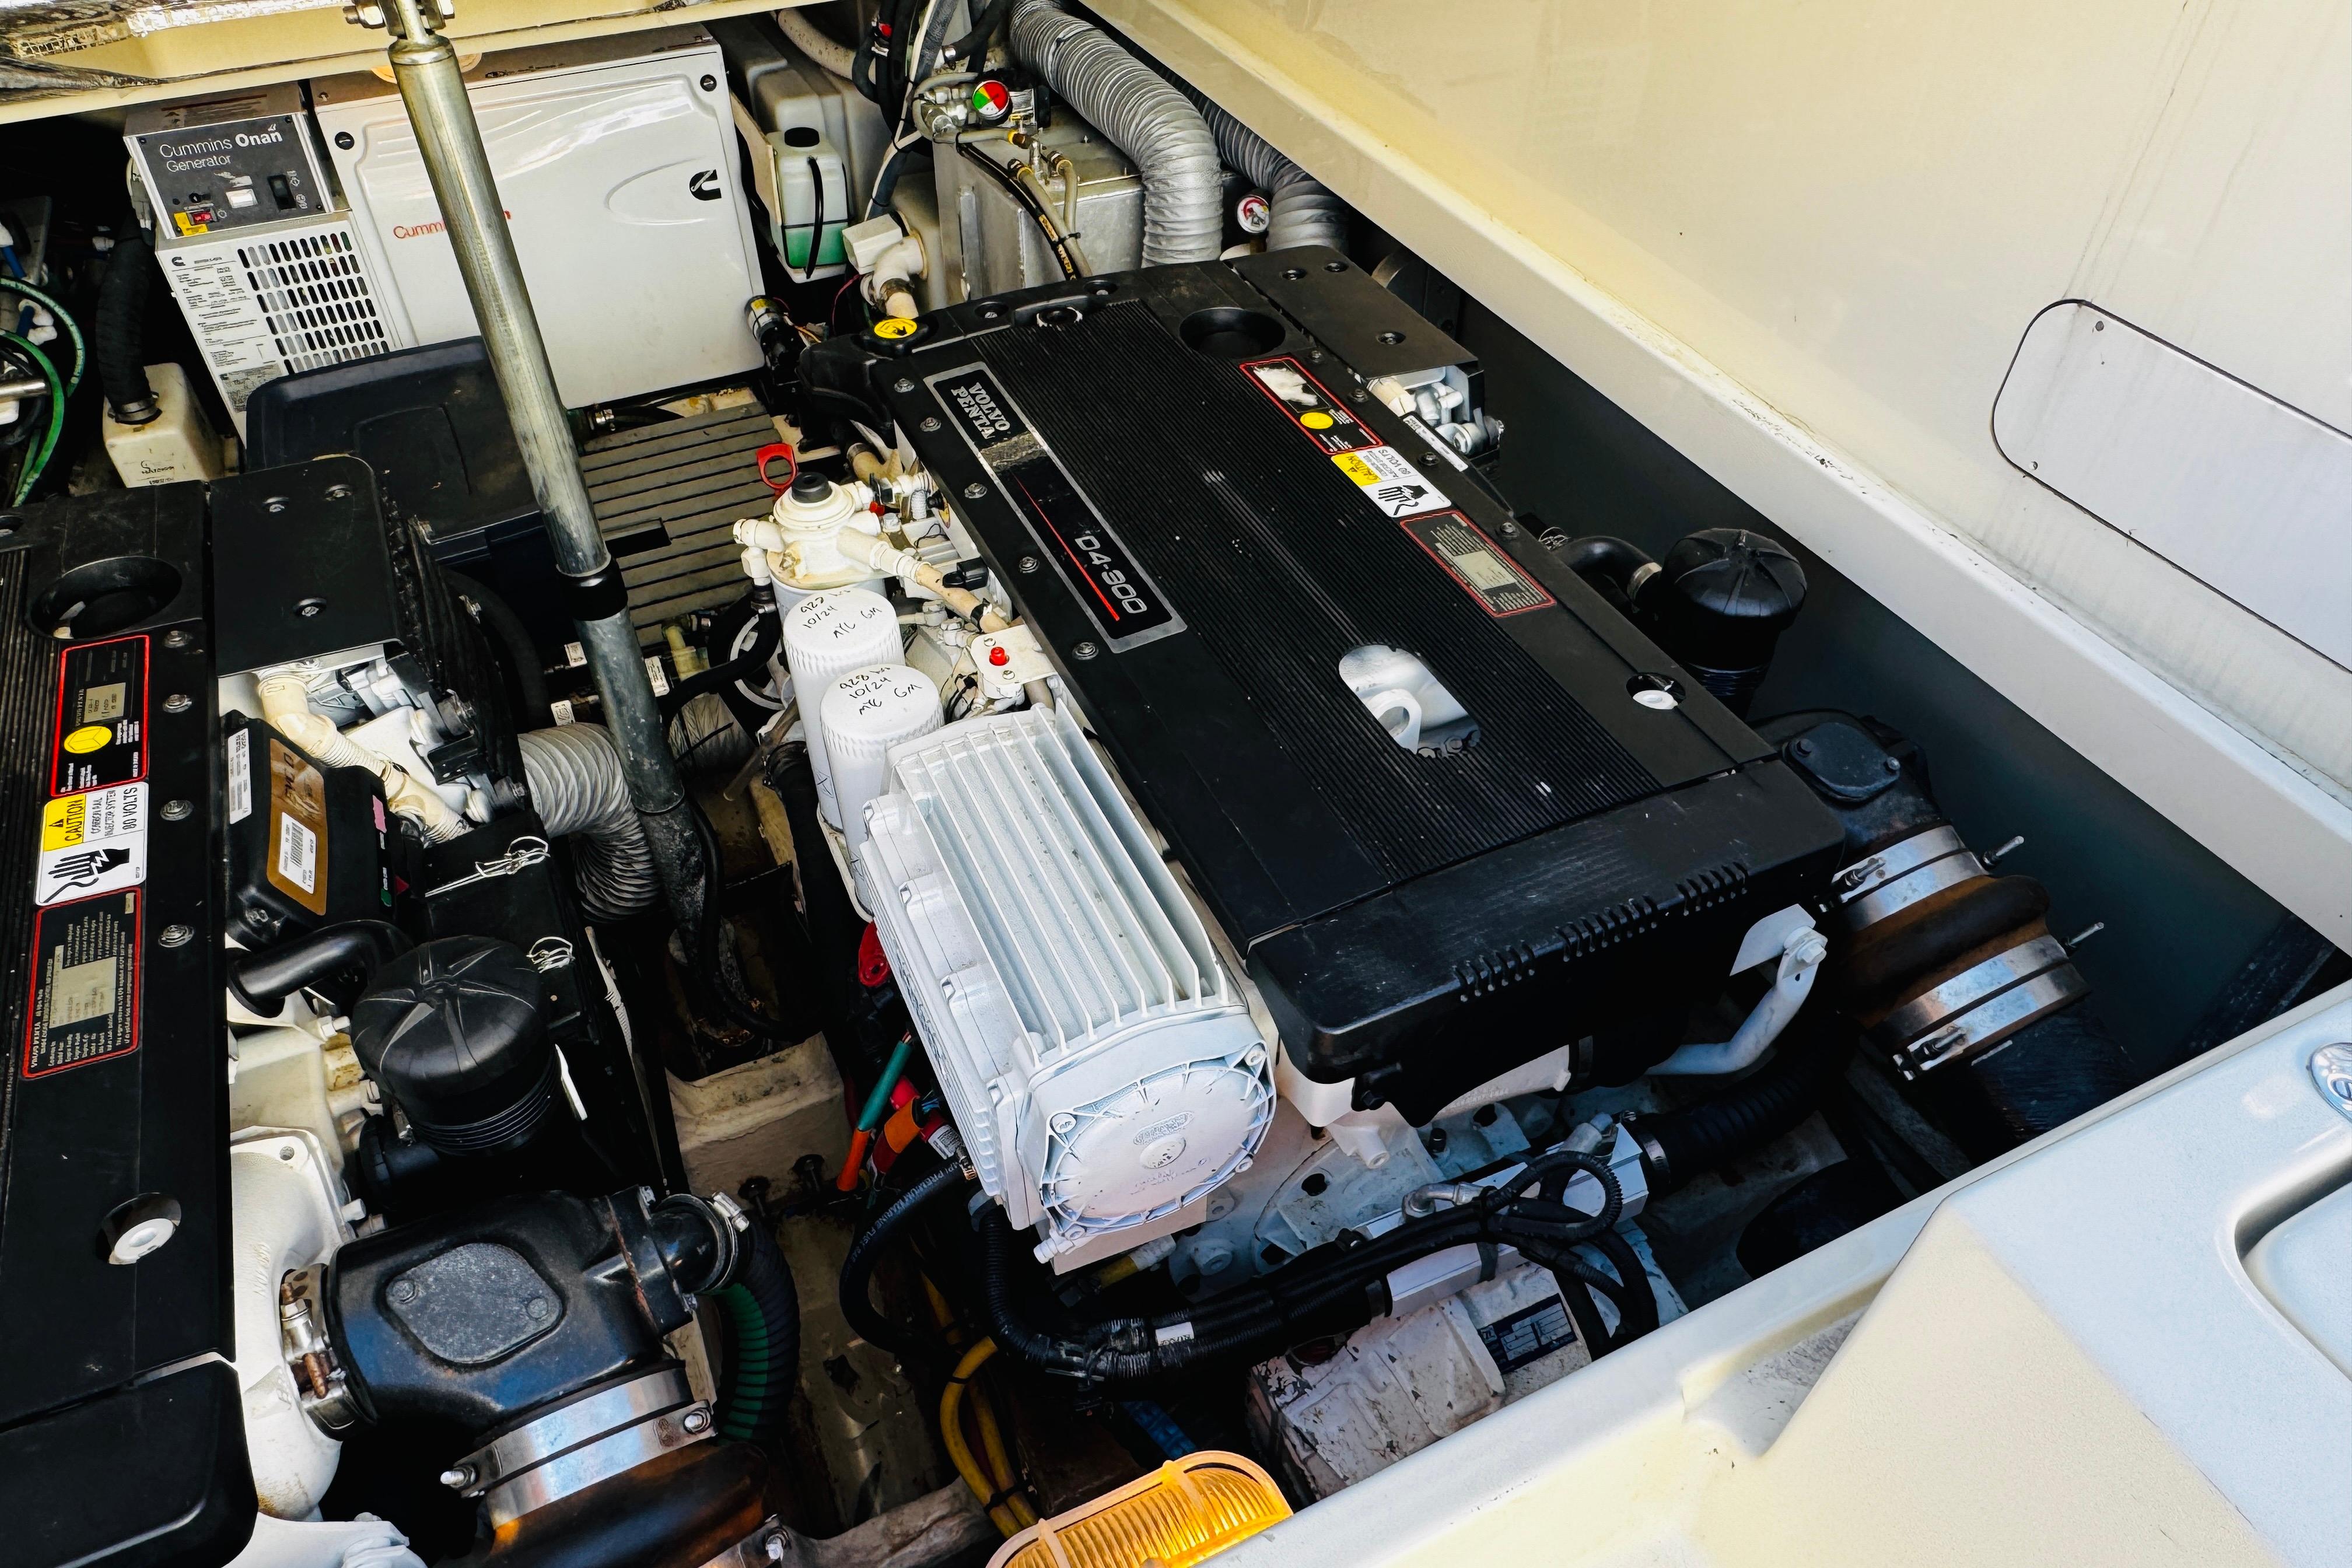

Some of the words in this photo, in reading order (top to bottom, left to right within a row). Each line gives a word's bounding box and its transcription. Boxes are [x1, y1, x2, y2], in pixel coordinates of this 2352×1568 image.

[159, 138, 232, 158] Cummins
[235, 130, 282, 148] Onan
[166, 155, 231, 173] Generator
[951, 386, 995, 439] PENTA
[969, 382, 1010, 432] VOLVO
[1378, 449, 1402, 468] VOLTS
[1074, 536, 1147, 614] D4-300
[849, 676, 892, 699] 10/24
[123, 787, 138, 817] VOLTS
[65, 799, 84, 841] CAUTION
[122, 818, 137, 831] 80
